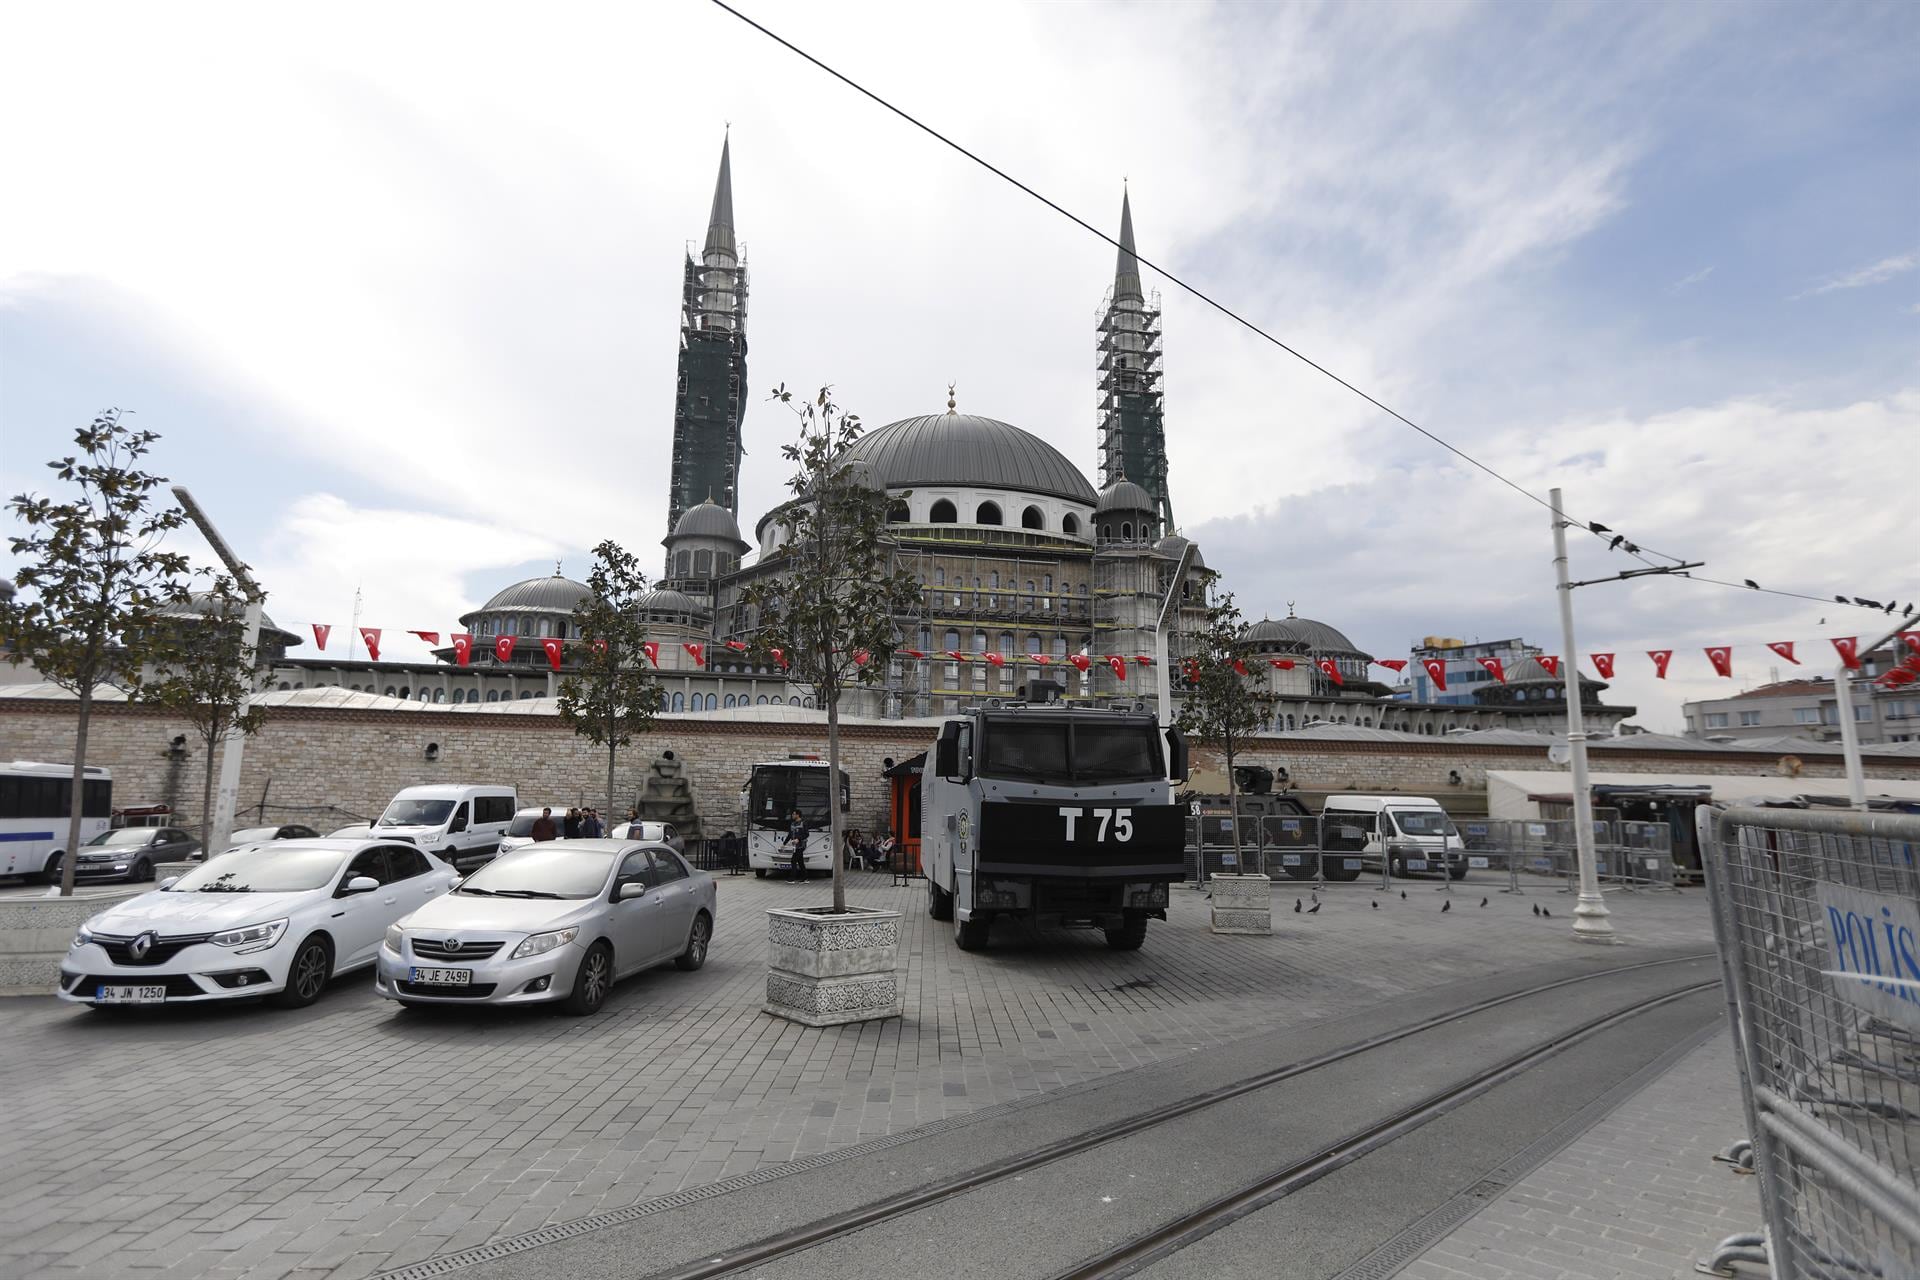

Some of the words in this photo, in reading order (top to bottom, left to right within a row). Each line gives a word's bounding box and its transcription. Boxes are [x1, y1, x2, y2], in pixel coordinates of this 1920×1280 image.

[1190, 805, 1201, 816] 58
[1059, 807, 1083, 841] T
[1093, 808, 1133, 842] 75
[414, 969, 426, 981] 34
[429, 970, 441, 981] JE
[444, 970, 468, 982] 2499
[104, 987, 116, 999] 34
[120, 987, 134, 999] JN
[139, 986, 164, 999] 1250
